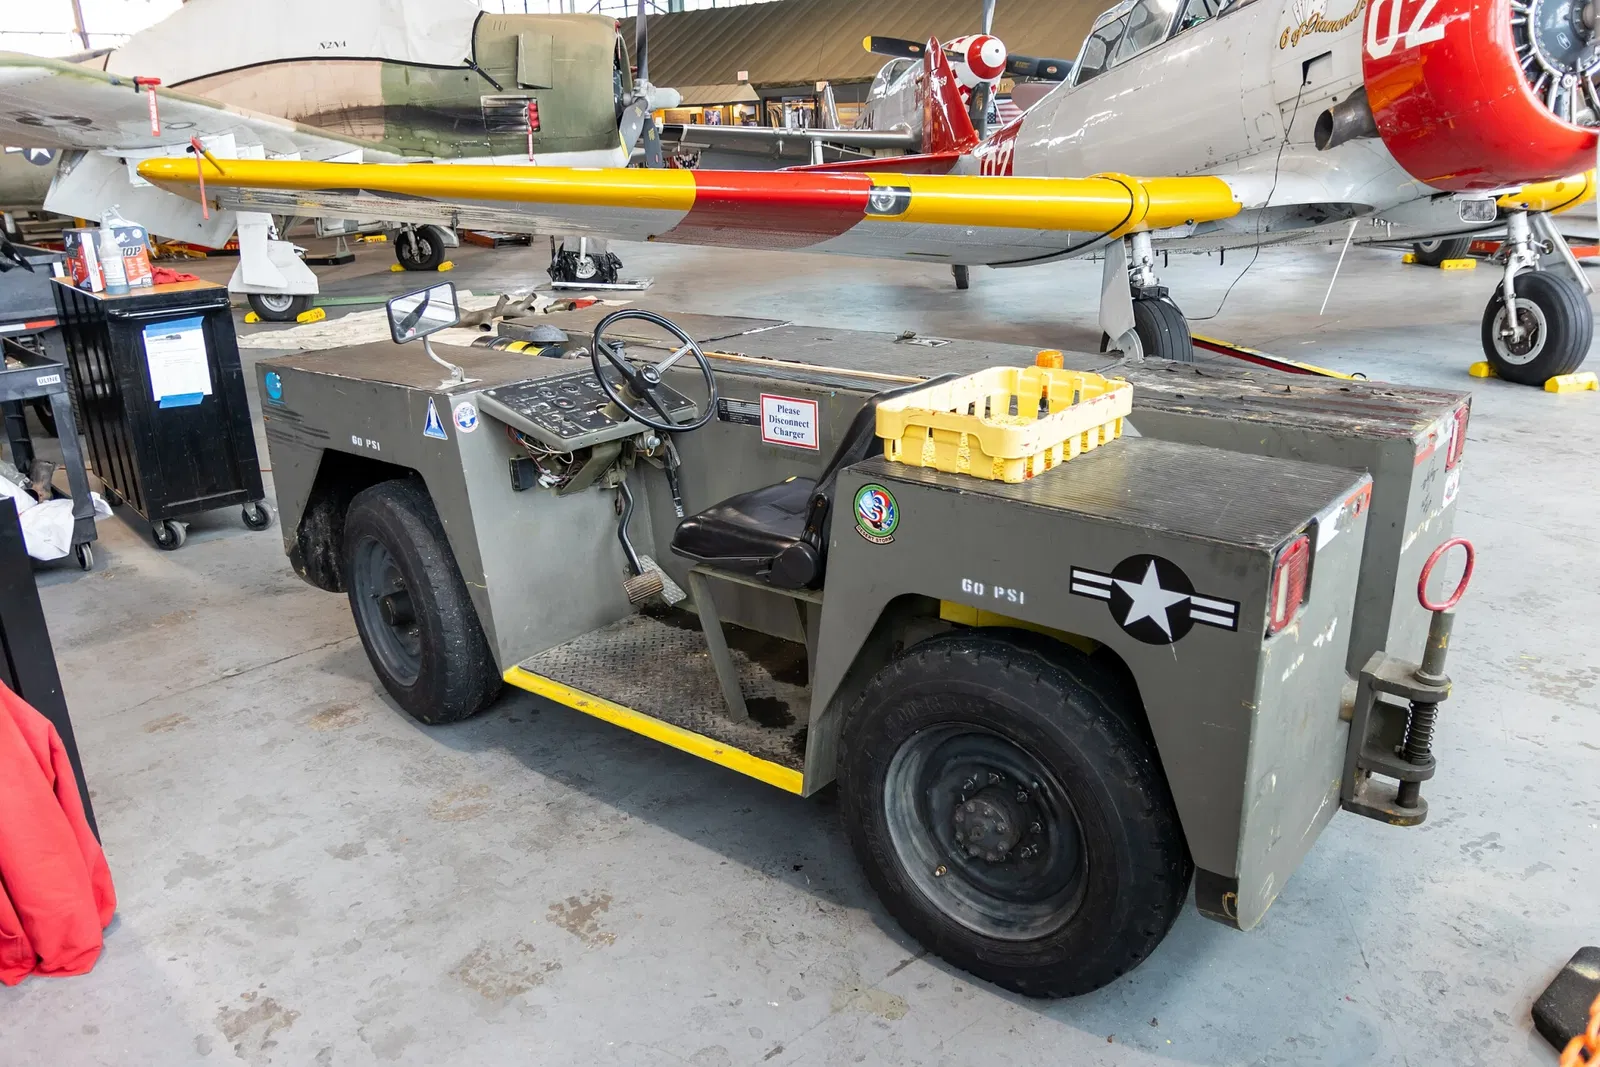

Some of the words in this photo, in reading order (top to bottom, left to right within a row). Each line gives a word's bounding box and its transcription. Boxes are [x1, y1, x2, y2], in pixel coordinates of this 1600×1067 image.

[1279, 27, 1290, 50] 6
[1290, 21, 1306, 48] of
[1302, 0, 1368, 37] Diamonds
[1366, 0, 1445, 60] 02
[38, 376, 58, 385] ULINE
[777, 404, 801, 416] Please
[768, 414, 810, 428] Disconnect
[773, 426, 806, 440] Charger
[366, 438, 381, 451] PSI
[857, 525, 875, 541] DESERT
[875, 535, 893, 543] STORM
[994, 585, 1025, 605] PSI
